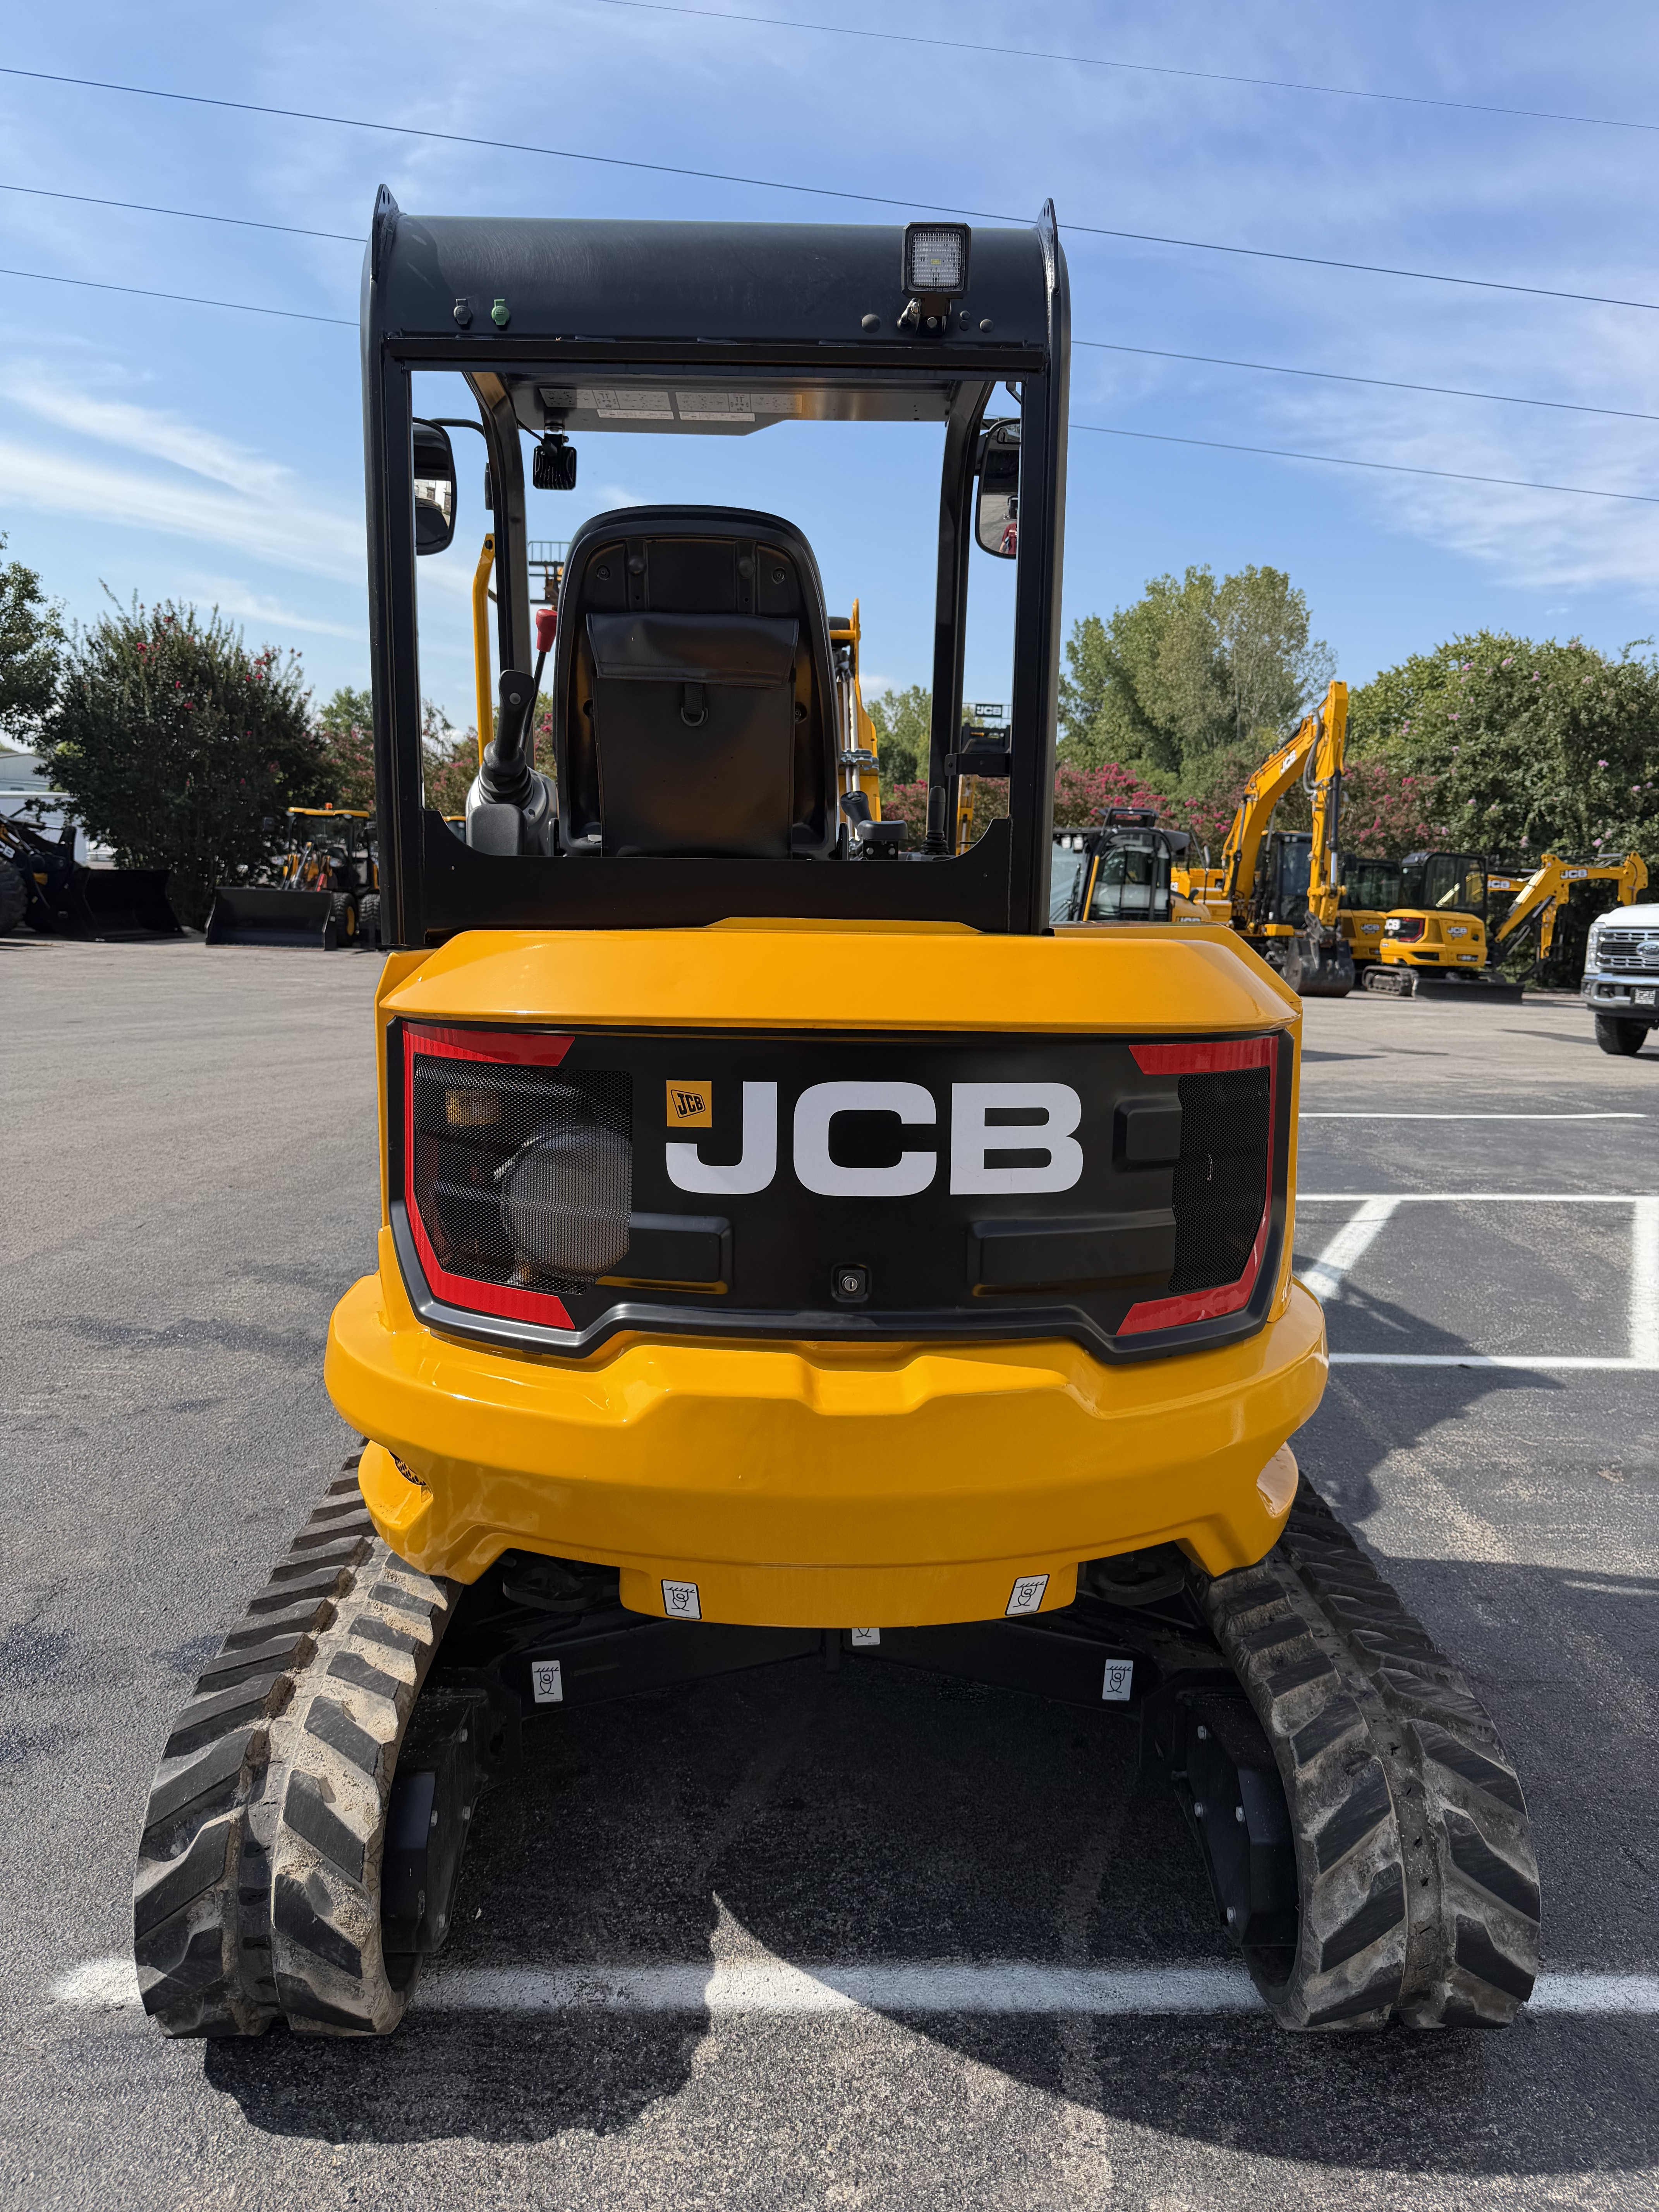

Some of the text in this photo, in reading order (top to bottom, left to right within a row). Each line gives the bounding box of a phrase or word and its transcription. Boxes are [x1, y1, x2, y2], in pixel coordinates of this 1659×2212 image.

[976, 706, 1001, 715] JCB
[1280, 749, 1296, 774] JCB
[1560, 869, 1587, 879] JCB
[677, 1093, 703, 1115] JCB
[666, 1082, 1083, 1197] JCB
